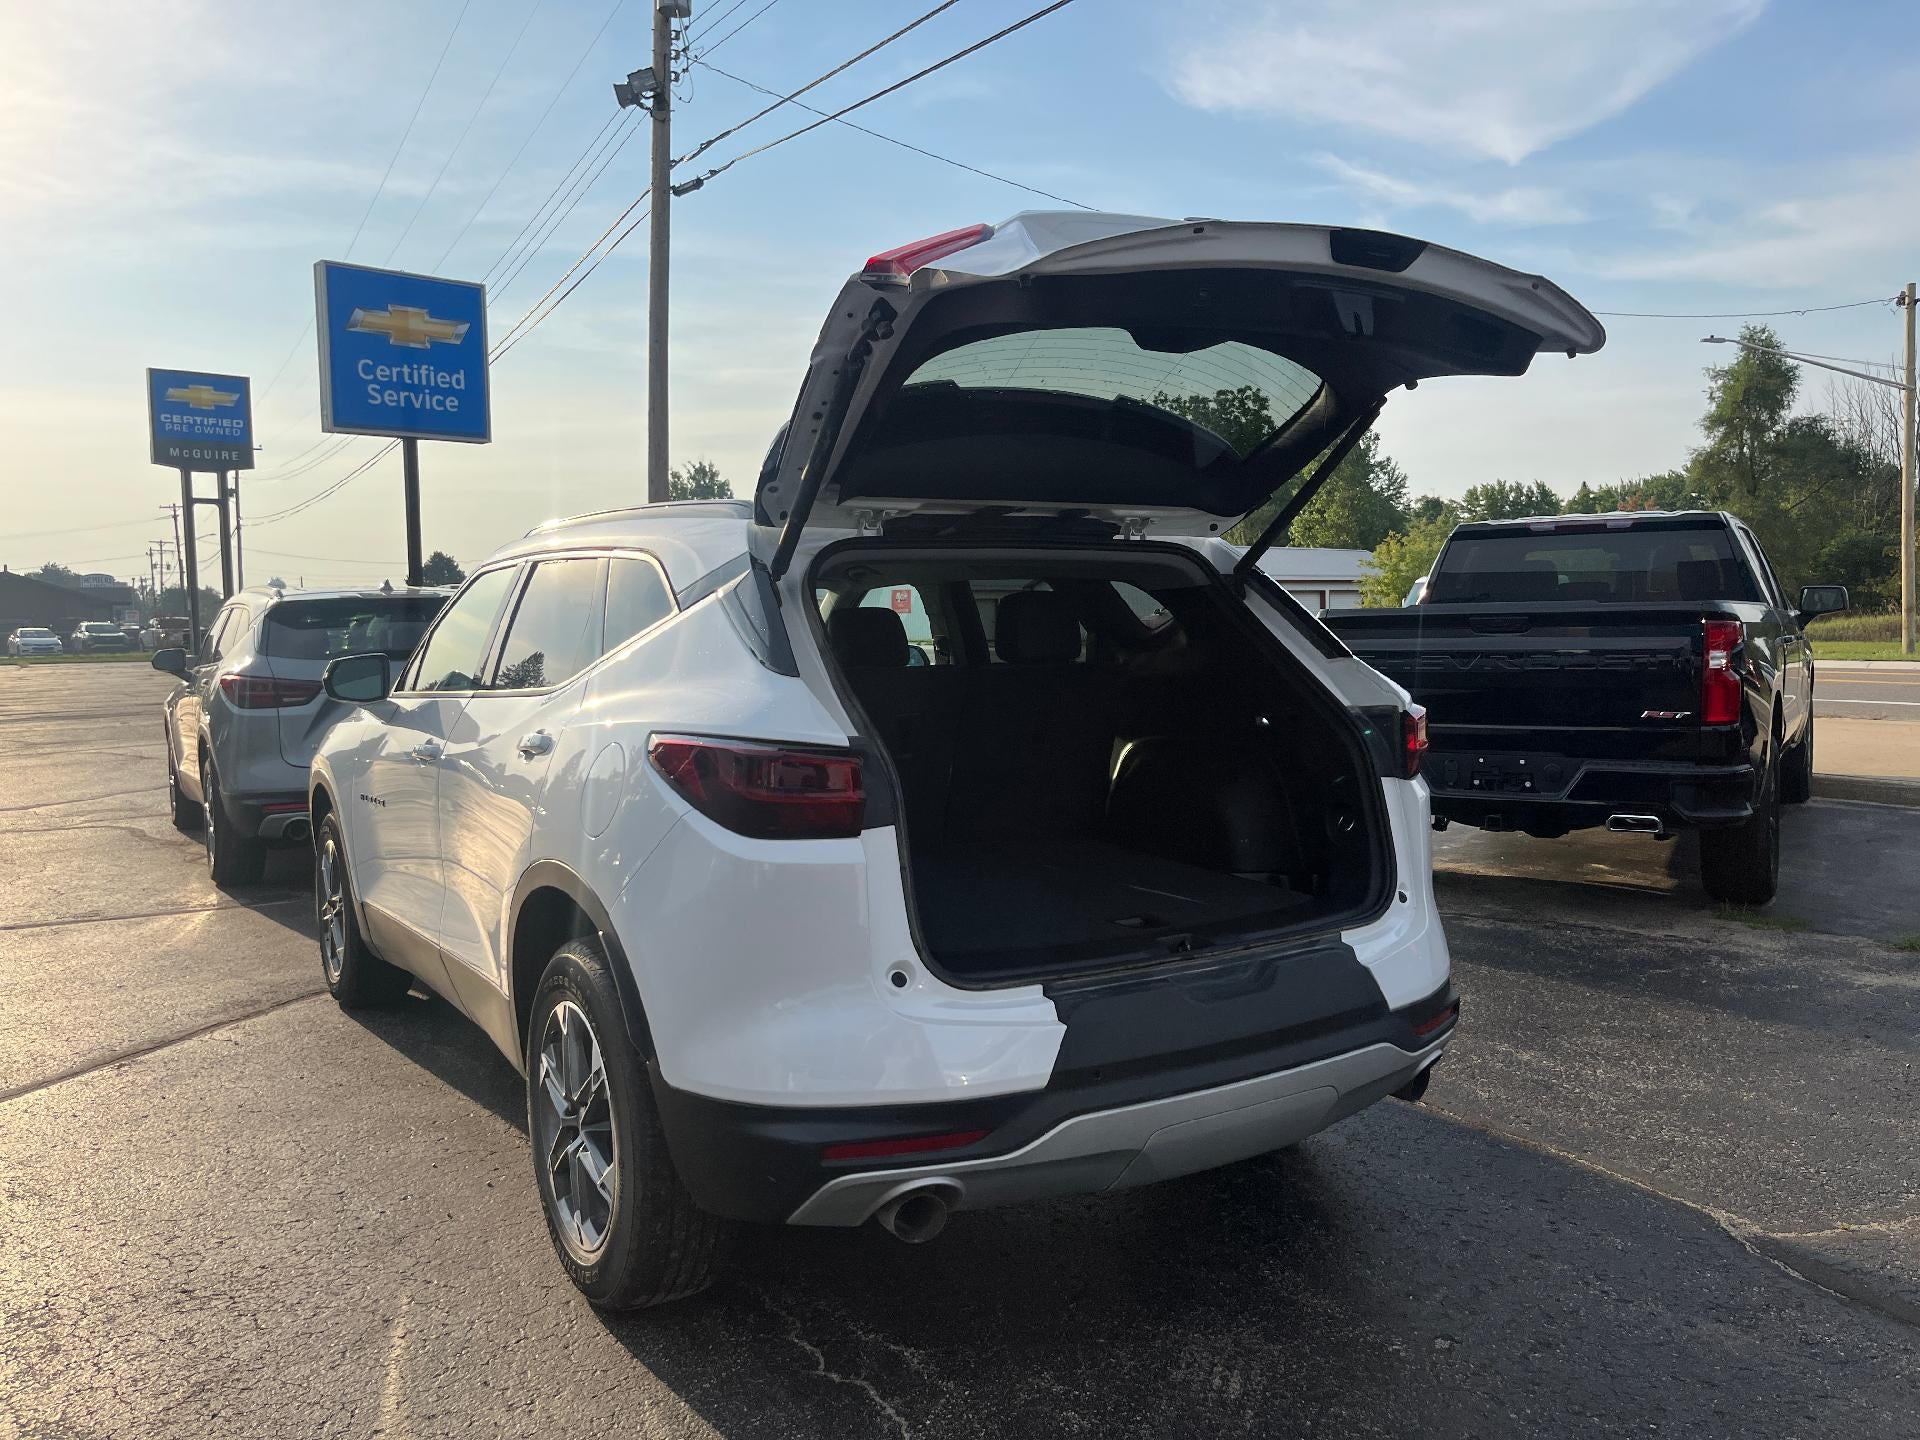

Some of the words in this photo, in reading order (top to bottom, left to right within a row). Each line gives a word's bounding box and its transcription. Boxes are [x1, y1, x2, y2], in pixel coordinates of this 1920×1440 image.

[357, 359, 465, 390] Certified
[367, 383, 459, 412] Service
[160, 414, 244, 428] CERTIFIED
[169, 447, 240, 461] McGUIRE
